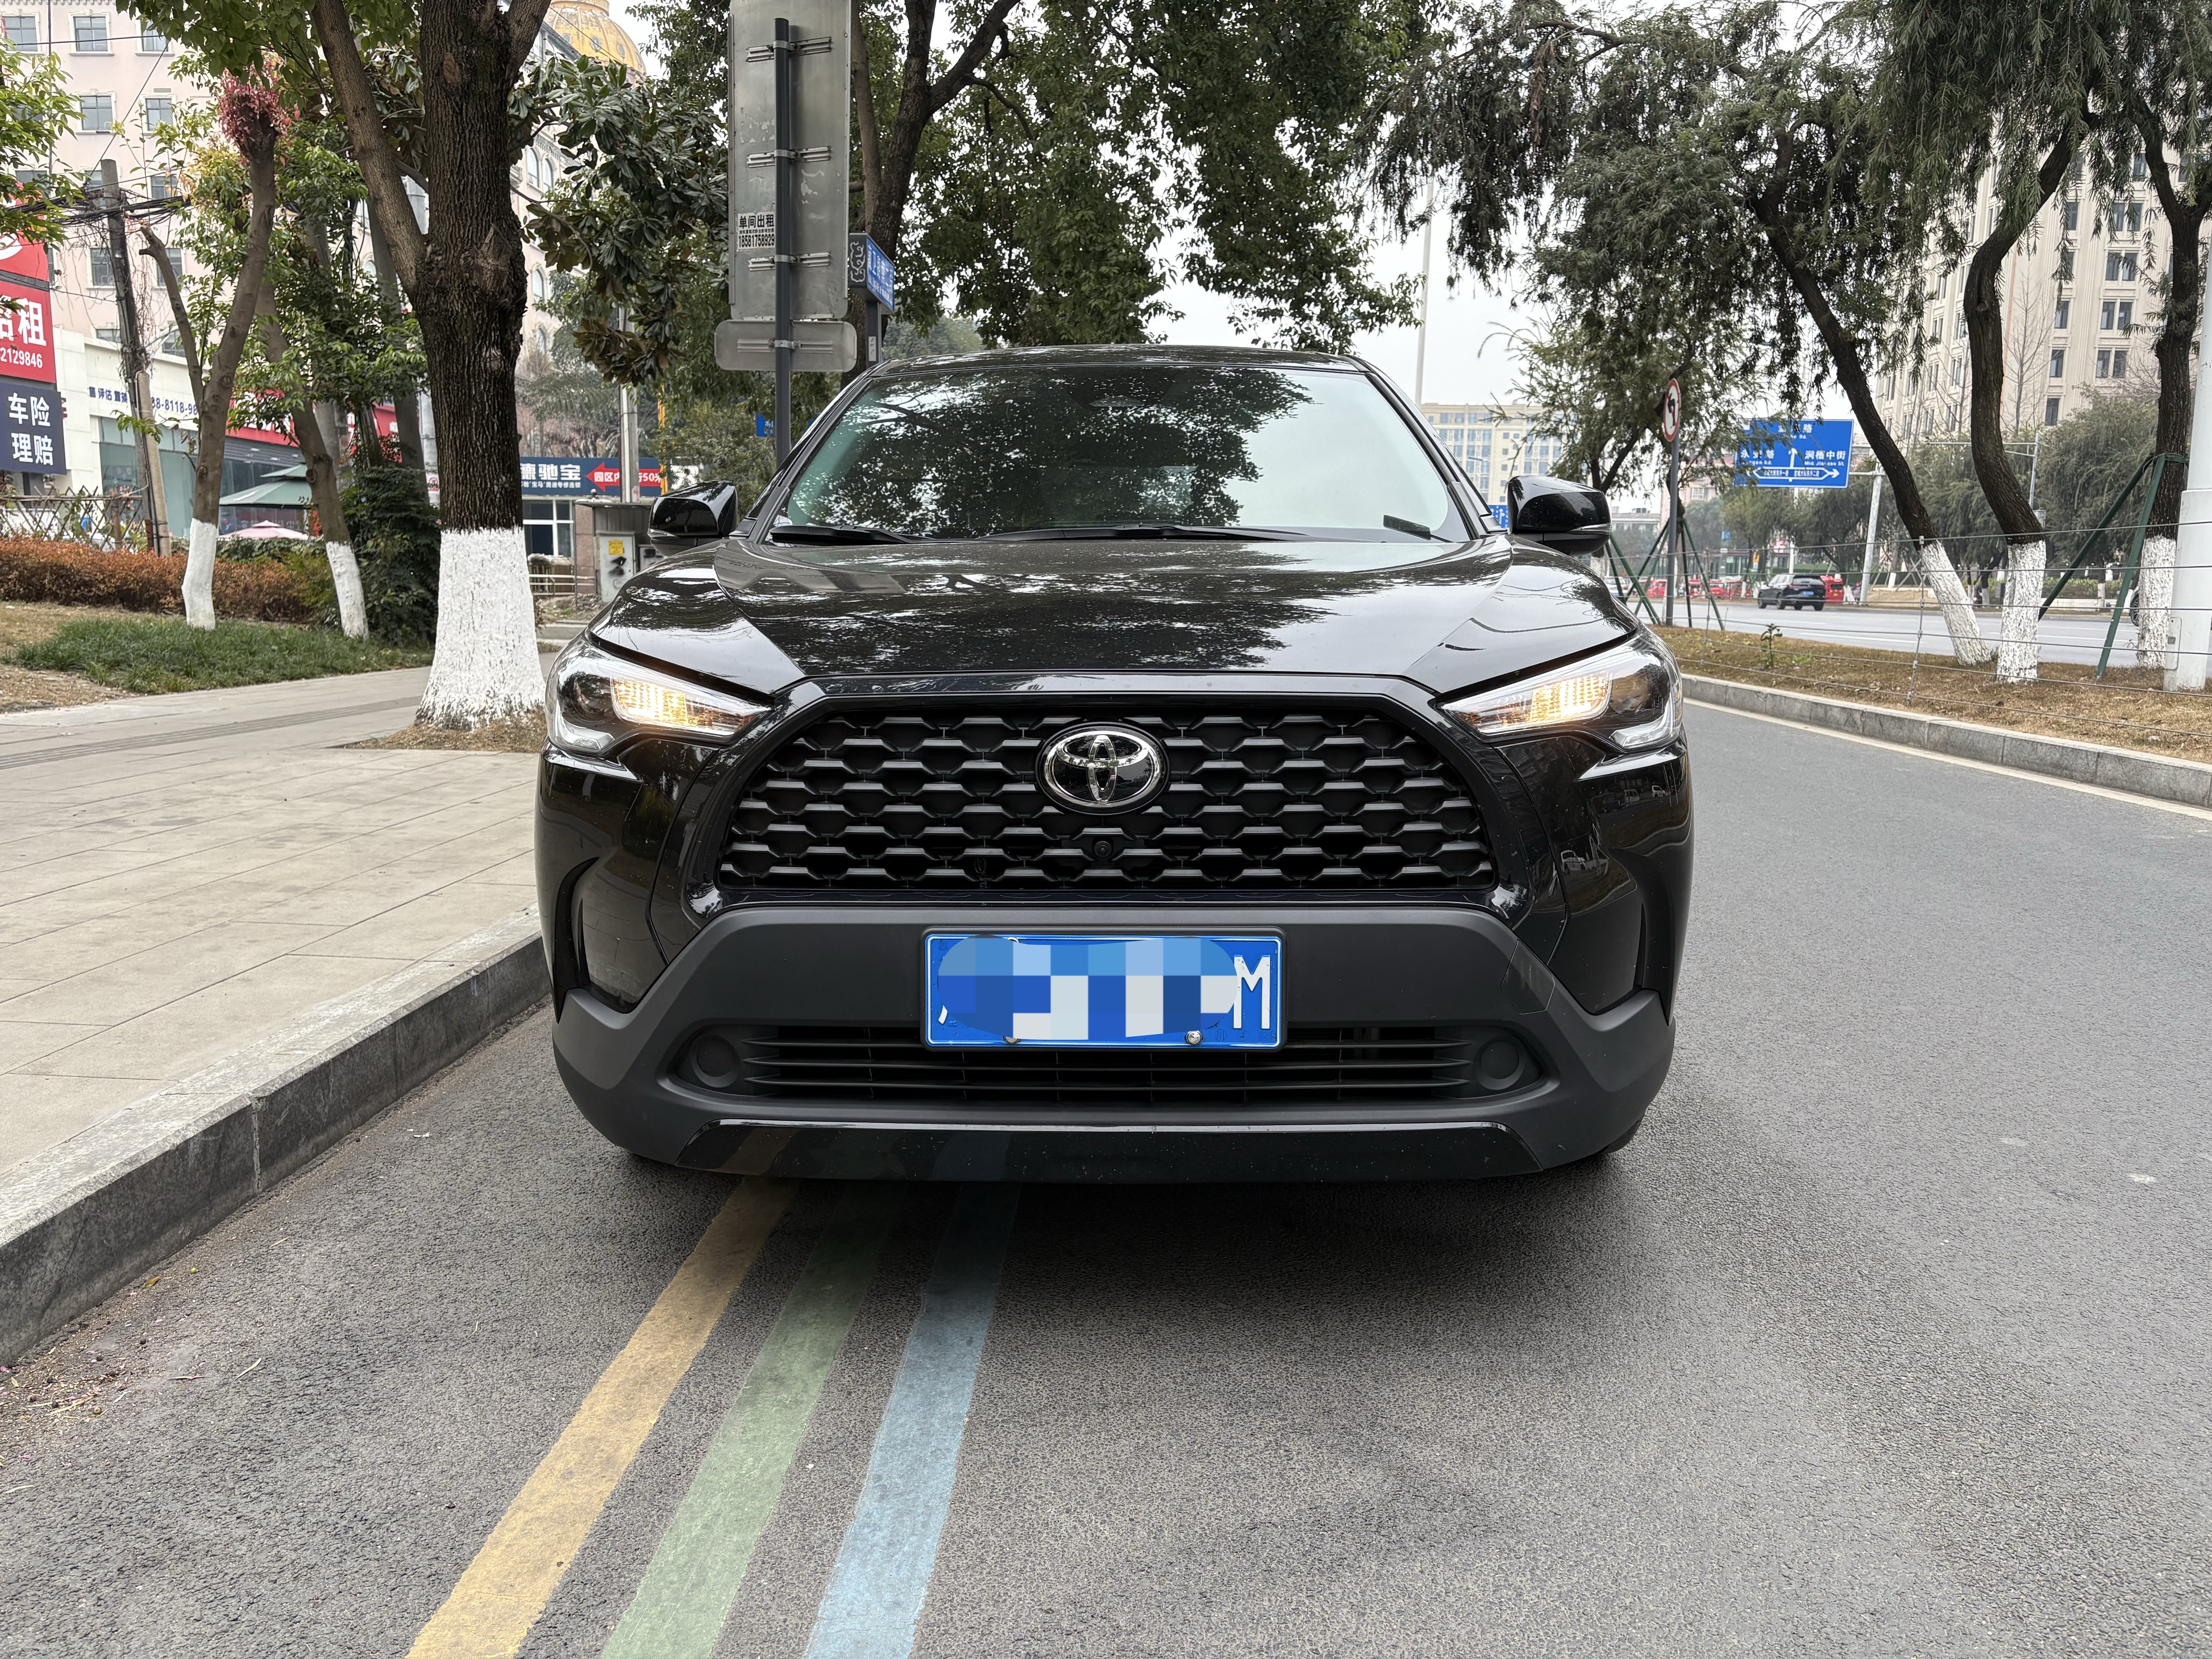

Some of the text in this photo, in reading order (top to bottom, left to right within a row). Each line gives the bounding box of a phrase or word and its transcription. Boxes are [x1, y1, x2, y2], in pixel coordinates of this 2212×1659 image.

[739, 214, 775, 229] 单间出租
[739, 234, 775, 247] 18581758929
[8, 392, 51, 427] 车险
[11, 433, 53, 465] 理赔
